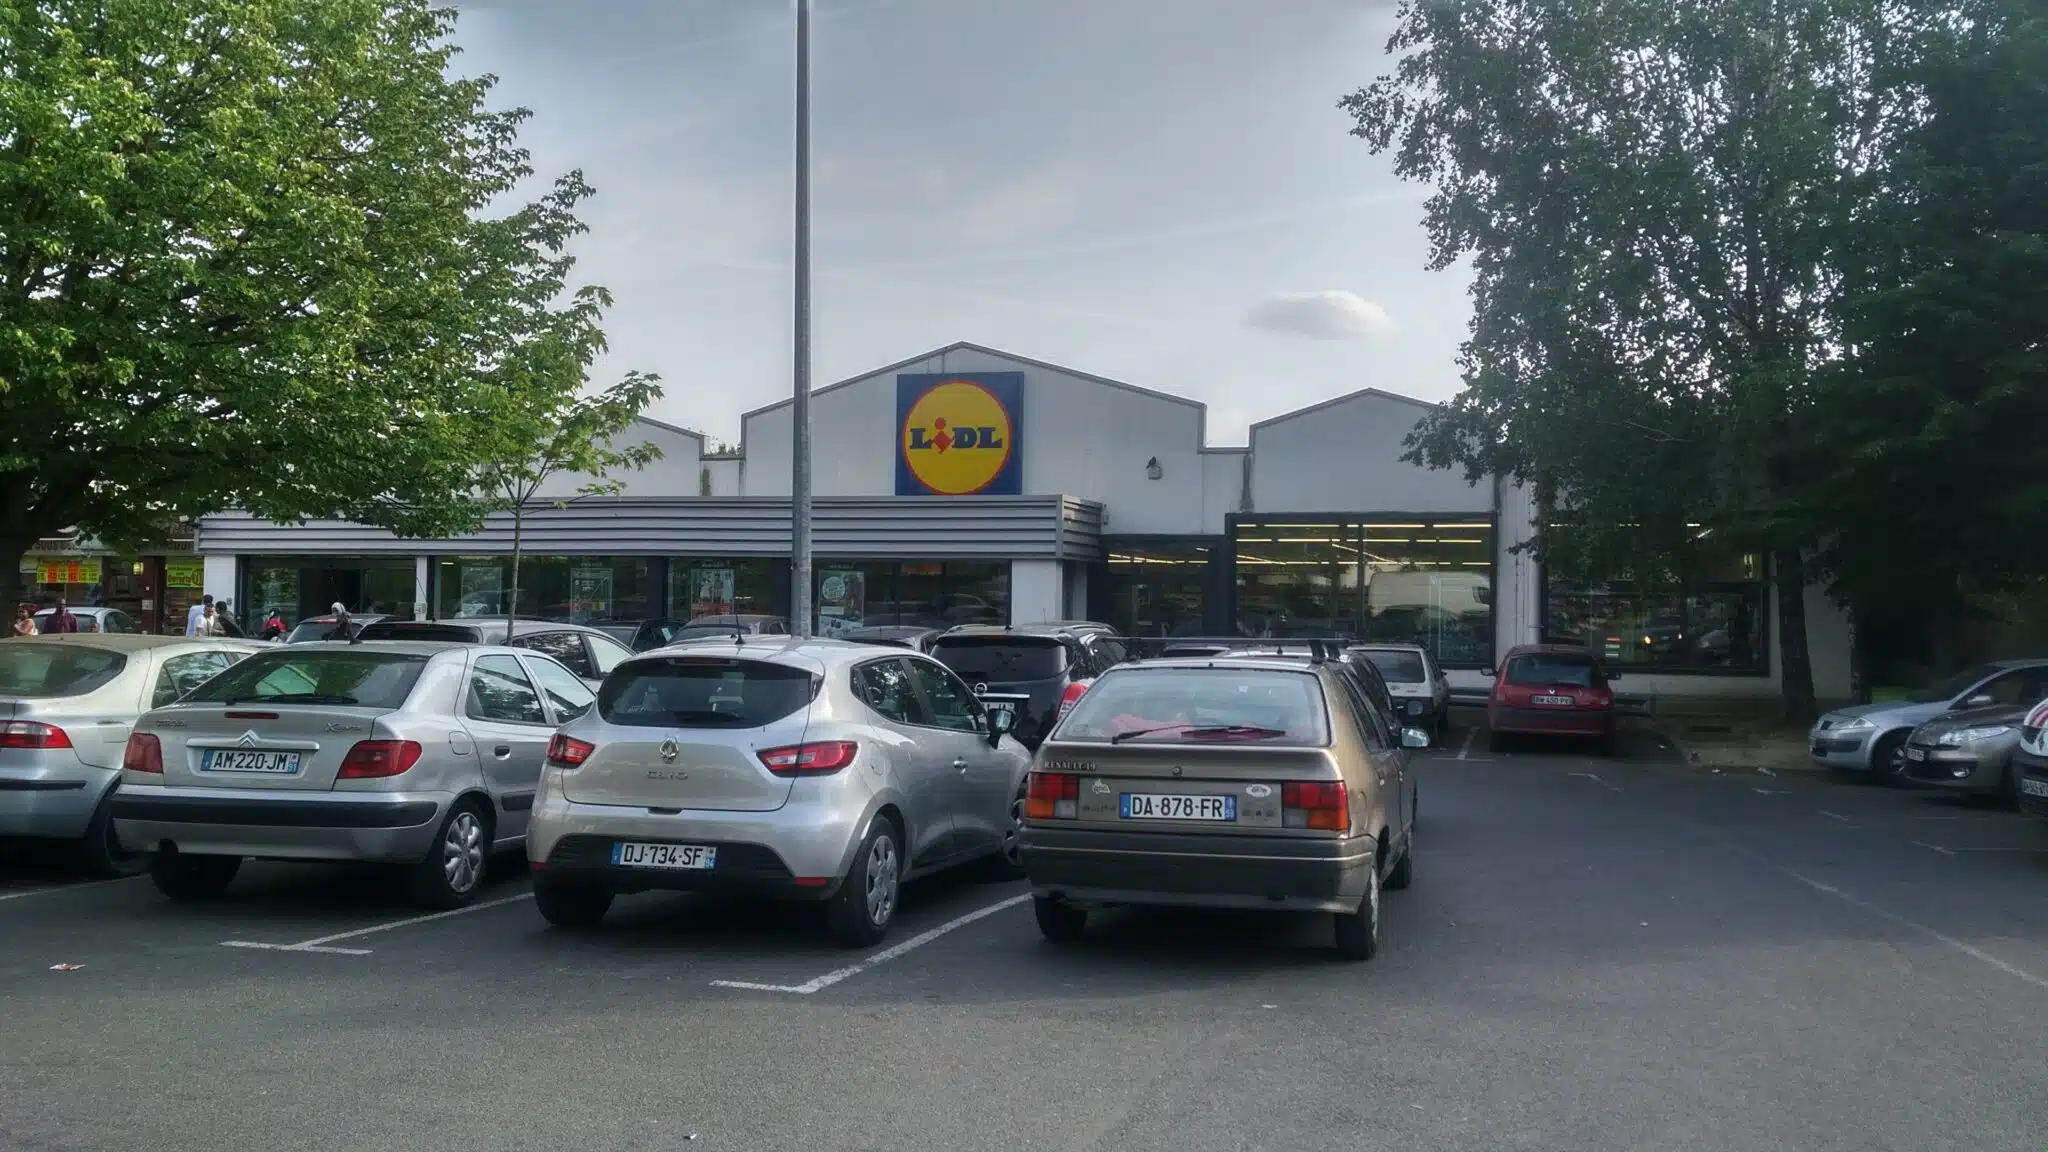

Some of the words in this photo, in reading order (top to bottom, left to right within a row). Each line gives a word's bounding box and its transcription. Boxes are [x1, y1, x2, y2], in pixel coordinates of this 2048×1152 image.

[213, 752, 288, 770] AM-220-JM
[1132, 796, 1223, 818] DA-878-FR
[623, 844, 704, 866] DJ-734-SF
